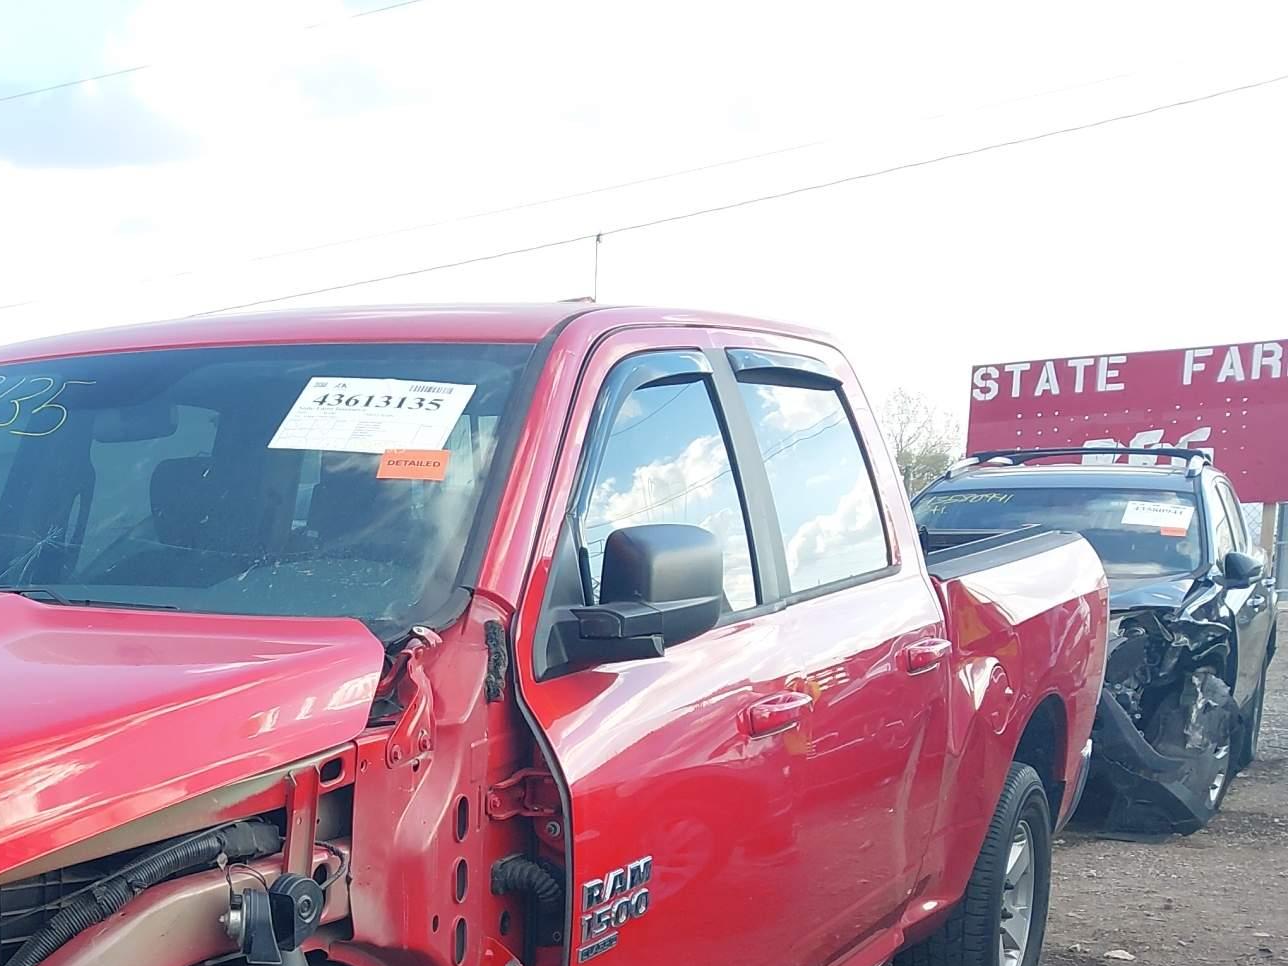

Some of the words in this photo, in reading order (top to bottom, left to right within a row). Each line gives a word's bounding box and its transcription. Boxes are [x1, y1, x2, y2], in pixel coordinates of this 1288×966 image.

[972, 355, 1128, 401] STATE
[1182, 342, 1288, 386] FAR
[313, 393, 445, 412] 43613135
[386, 459, 441, 468] DETAILED
[581, 855, 653, 913] RAM
[580, 887, 650, 944] 1500
